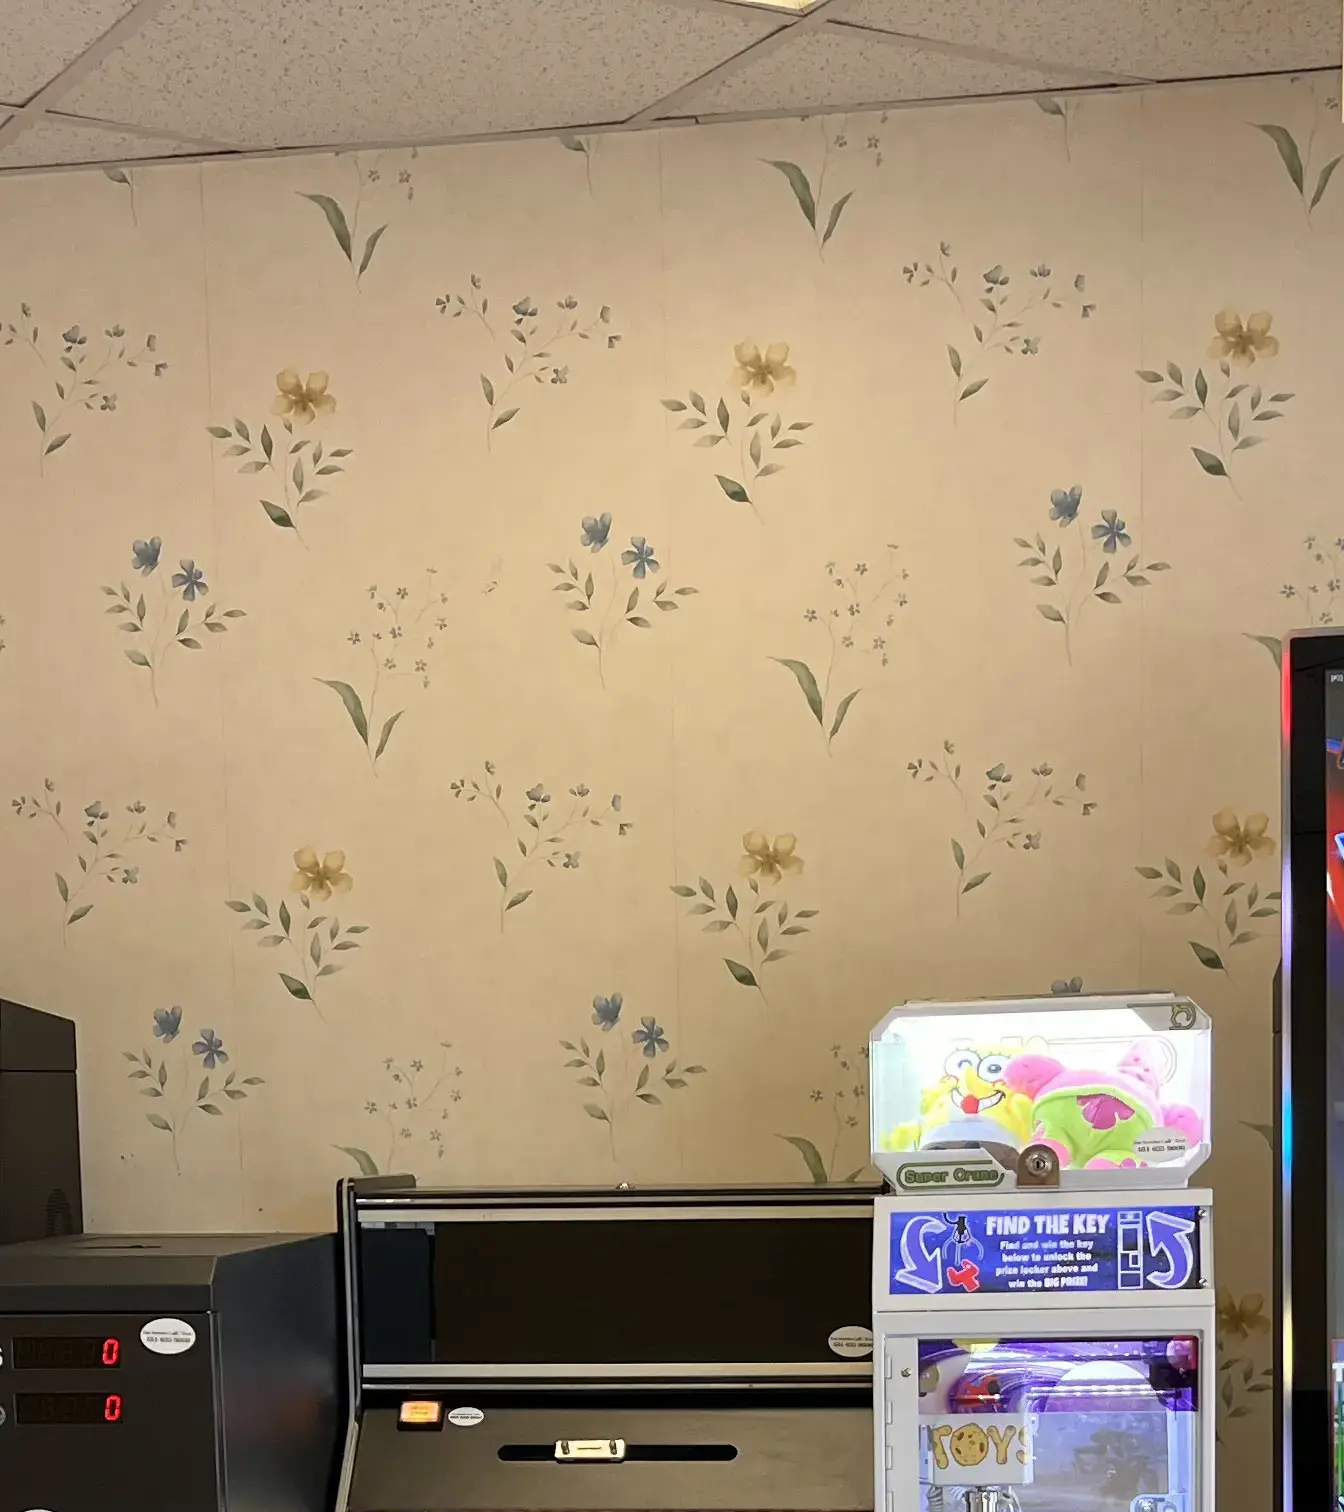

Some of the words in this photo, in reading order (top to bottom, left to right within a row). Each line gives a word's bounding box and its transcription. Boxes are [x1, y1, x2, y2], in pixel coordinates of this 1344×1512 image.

[985, 1215, 1031, 1236] FIND
[1034, 1213, 1070, 1235] THE
[1073, 1213, 1111, 1235] KEY
[1059, 1240, 1075, 1249] the
[1076, 1239, 1094, 1251] key
[1031, 1252, 1042, 1262] to
[1043, 1251, 1074, 1262] unlock
[1075, 1251, 1092, 1261] the
[995, 1264, 1018, 1277] prize
[1020, 1264, 1050, 1275] locker
[1051, 1263, 1079, 1274] above
[1080, 1262, 1099, 1273] and
[1008, 1279, 1026, 1288] win
[1027, 1278, 1042, 1288] the
[1044, 1276, 1060, 1288] BIG
[102, 1337, 120, 1365] 0
[104, 1394, 122, 1421] 0
